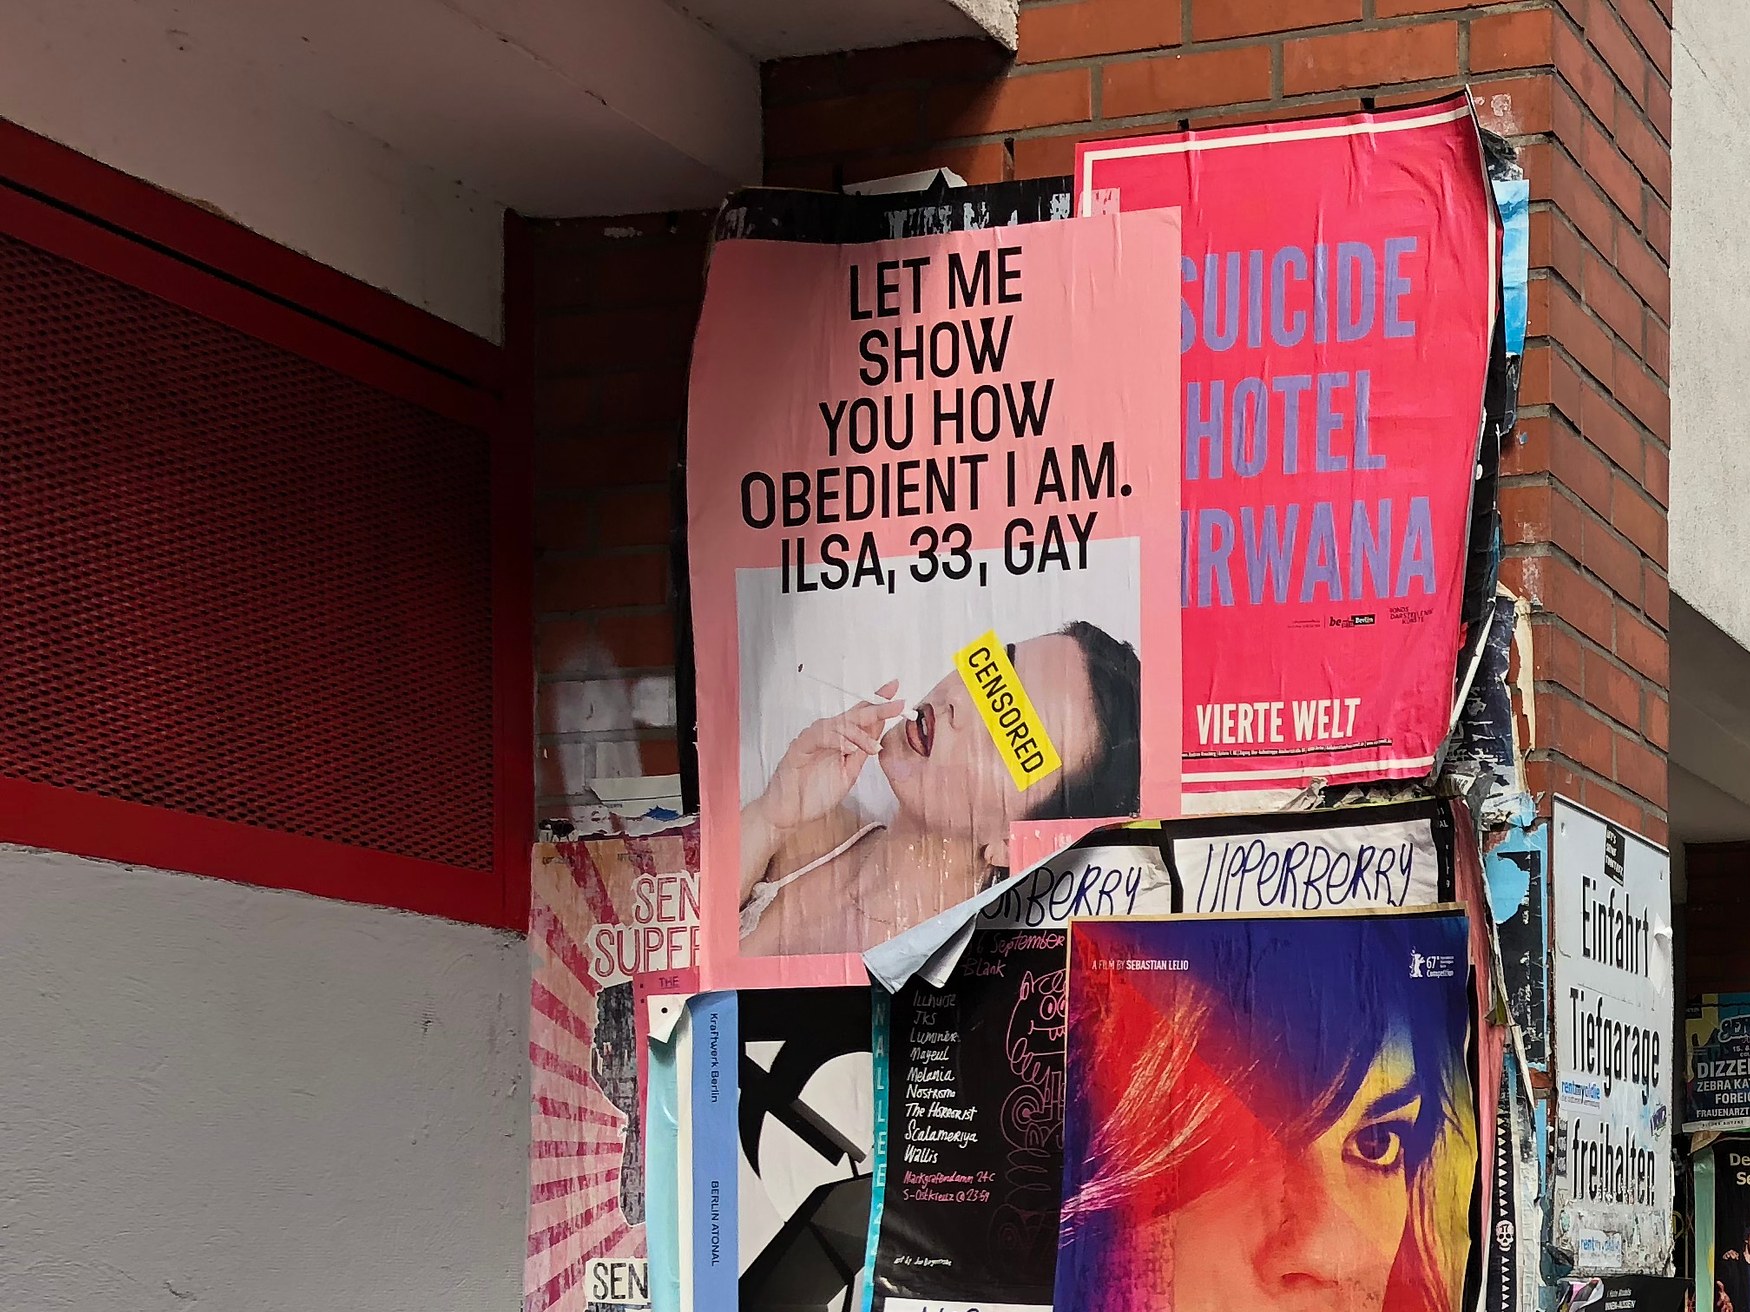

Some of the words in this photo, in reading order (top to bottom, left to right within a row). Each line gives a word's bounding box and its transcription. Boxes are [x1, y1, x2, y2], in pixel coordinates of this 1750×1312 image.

[849, 256, 931, 322] LET
[948, 246, 1024, 311] ME
[1181, 236, 1417, 353] SUICIDE
[859, 316, 1014, 388] SHOW
[819, 390, 914, 457] YOU
[932, 379, 1056, 448] HOW
[1186, 370, 1386, 480] HOTEL
[740, 455, 990, 530] OBEDIENT
[1004, 449, 1015, 506] I
[1034, 442, 1134, 502] AM.
[781, 530, 896, 596] ILSA,
[910, 524, 990, 587] 33,
[1003, 512, 1099, 575] GAY
[1181, 496, 1436, 608] IRWANA
[966, 644, 1046, 774] CENSORED
[1197, 702, 1284, 745] VIERTE
[1292, 698, 1361, 742] WELT
[1581, 876, 1650, 978] Einfahrt
[708, 1012, 719, 1069] Kraftwerk
[1570, 987, 1660, 1101] Tiefgarage
[710, 1071, 719, 1103] Berlin
[1697, 1079, 1731, 1092] ZEBRA
[711, 1181, 720, 1221] BERLIN
[1572, 1123, 1655, 1206] freihalten
[711, 1225, 720, 1266] ATONAL
